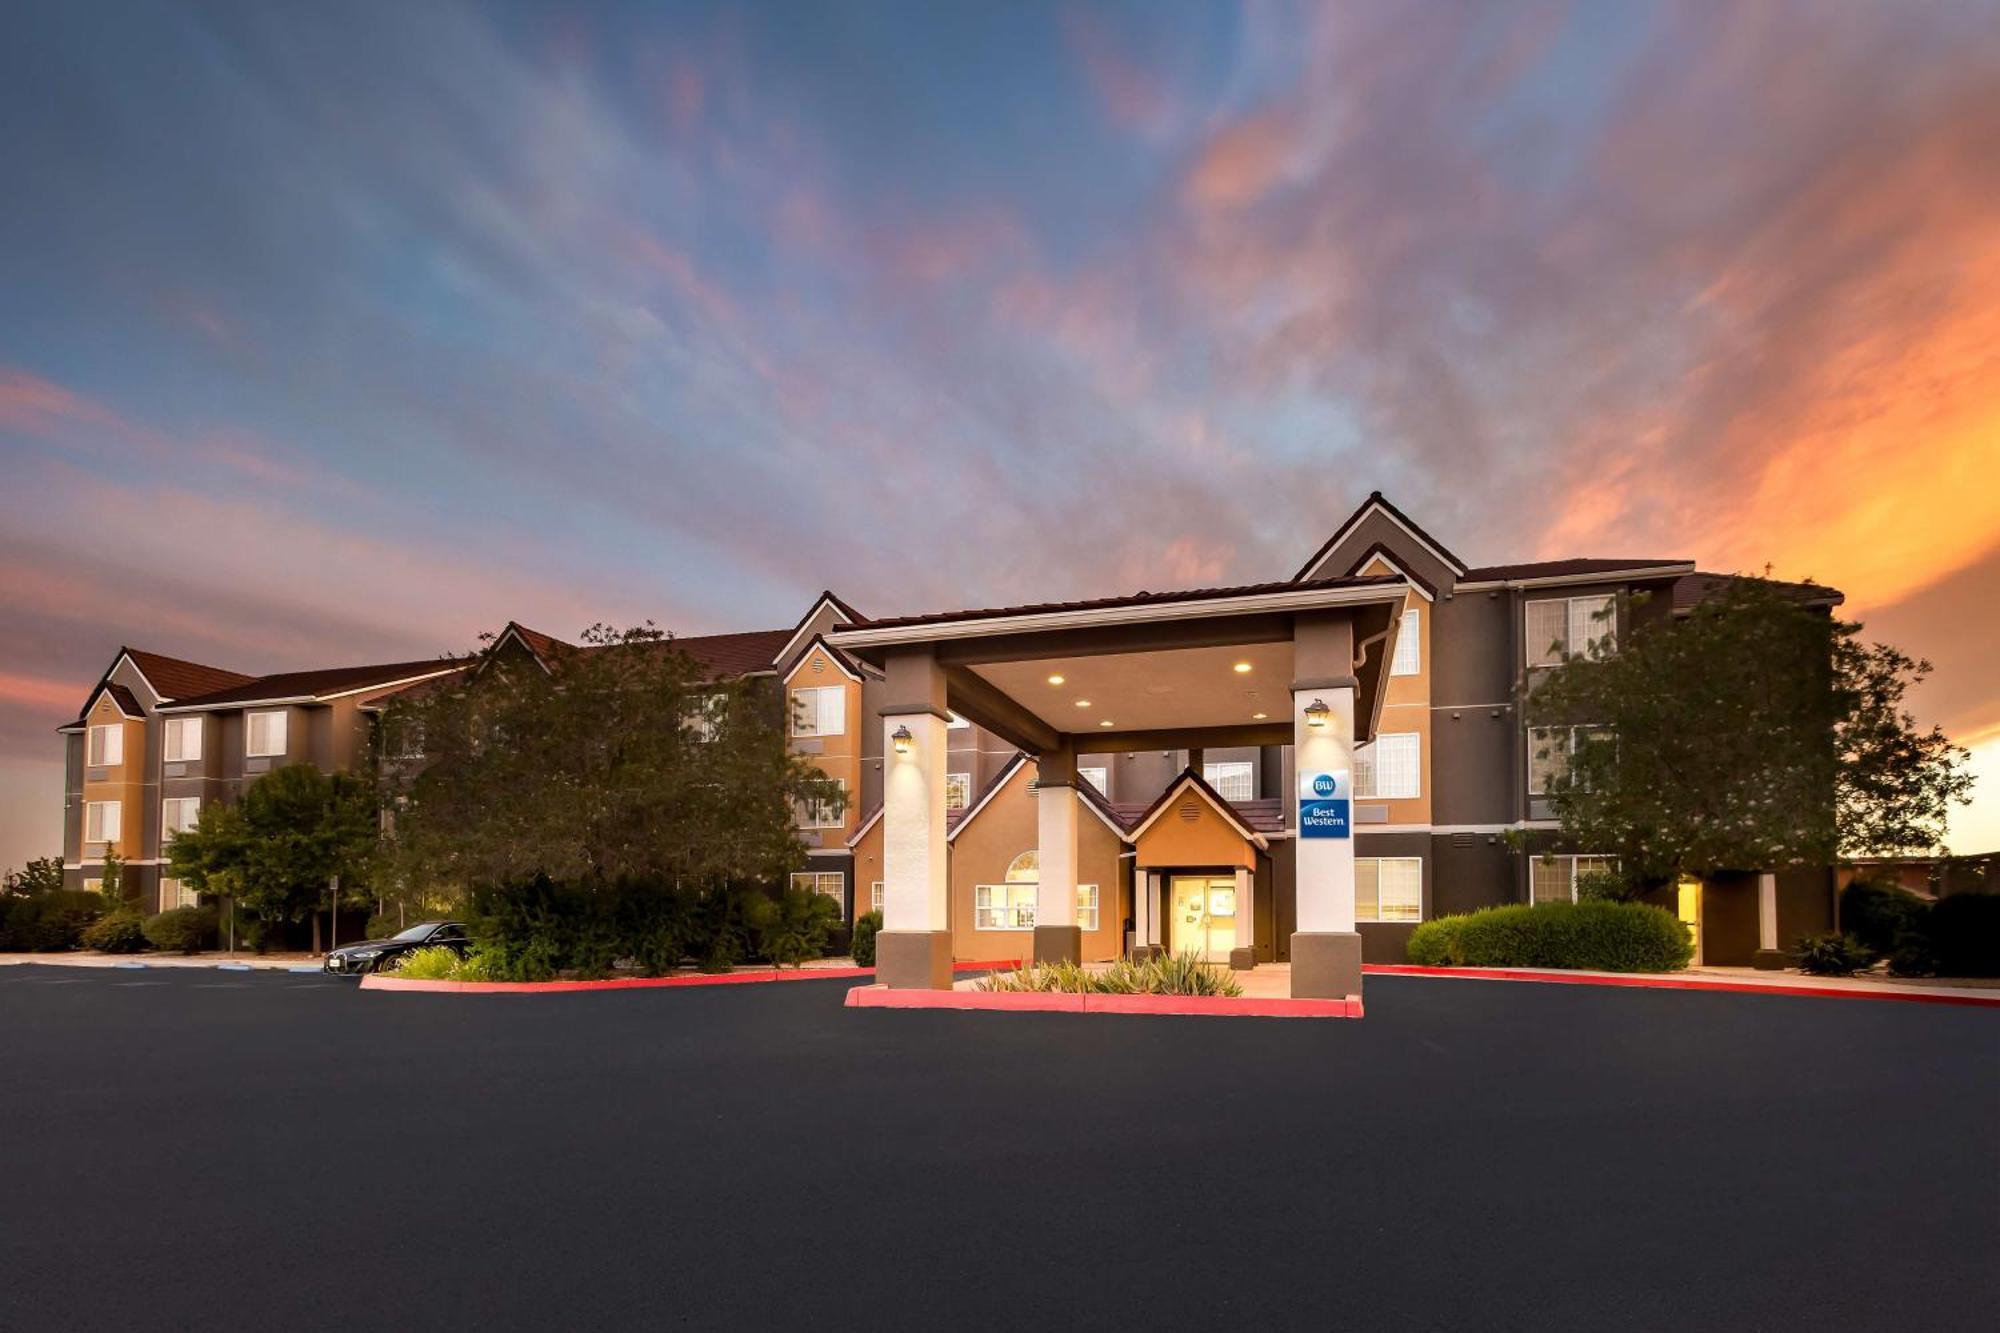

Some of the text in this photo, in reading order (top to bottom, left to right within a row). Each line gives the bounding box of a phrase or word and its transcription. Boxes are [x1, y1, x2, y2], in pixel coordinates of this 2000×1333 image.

[1315, 781, 1333, 791] BW
[1312, 807, 1335, 817] Best
[1303, 816, 1344, 826] Western
